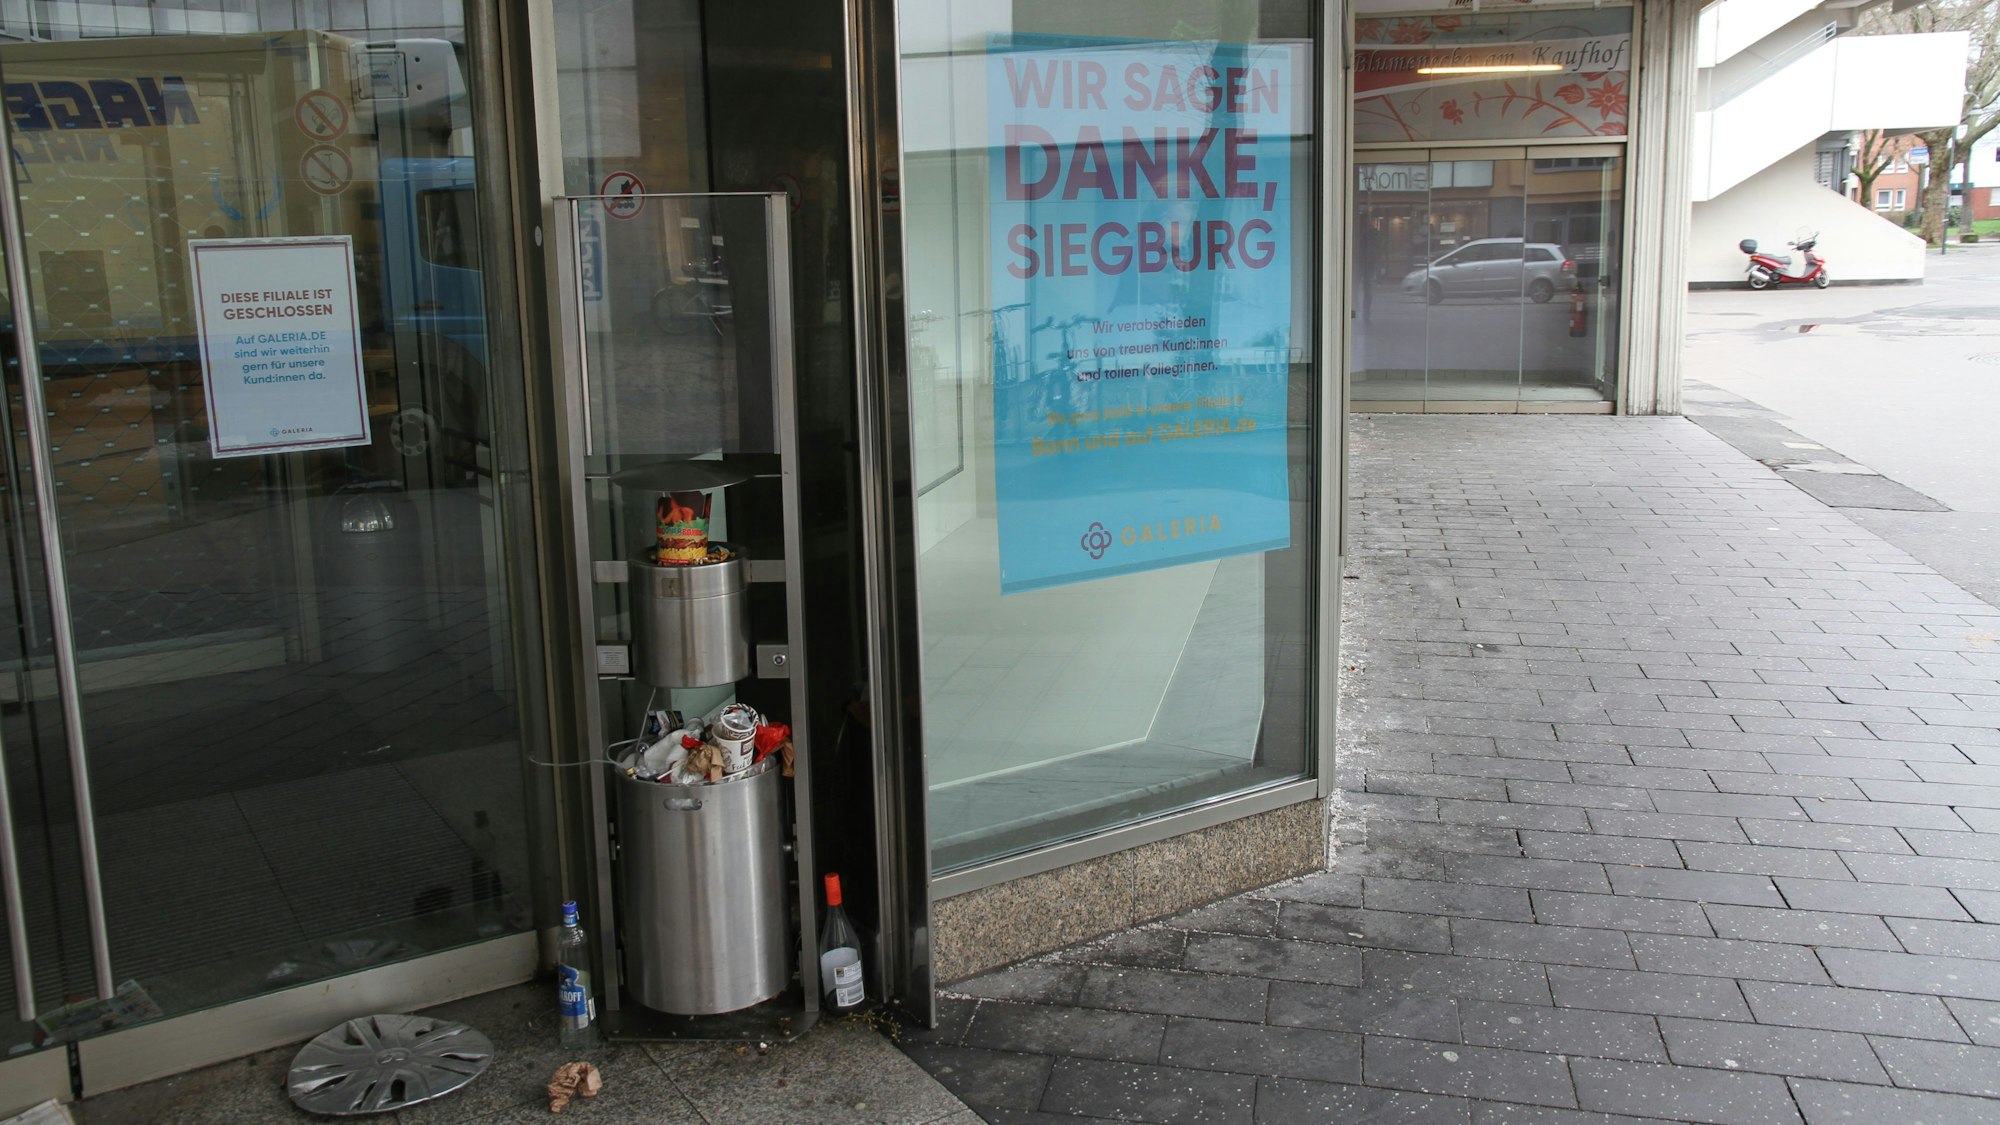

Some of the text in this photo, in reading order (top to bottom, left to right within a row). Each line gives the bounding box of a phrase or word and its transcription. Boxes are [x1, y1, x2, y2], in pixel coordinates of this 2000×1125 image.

[1354, 40, 1628, 72] Blumenecke am Kaufhof
[1003, 58, 1279, 114] WIR SAGEN
[1004, 124, 1277, 211] DANKE,
[1006, 218, 1276, 280] SIEGBURG
[221, 288, 333, 303] DIESE FILIALE IST
[223, 304, 333, 320] GESCHLOSSEN
[1092, 316, 1206, 334] Wir verabschieden
[235, 331, 327, 345] Auf GALERIA.DE
[1066, 336, 1228, 360] uns von treuen Kund:innen
[234, 344, 330, 359] sind wir weiterhin
[242, 358, 325, 374] gern für unsere
[1076, 360, 1218, 382] und tollen Kolleg:innen.
[243, 371, 327, 385] Kund:innen da.
[281, 427, 313, 435] GALERIA
[1031, 416, 1257, 457] Bonn und auf GALERIA.de
[1121, 514, 1222, 546] GALERIA
